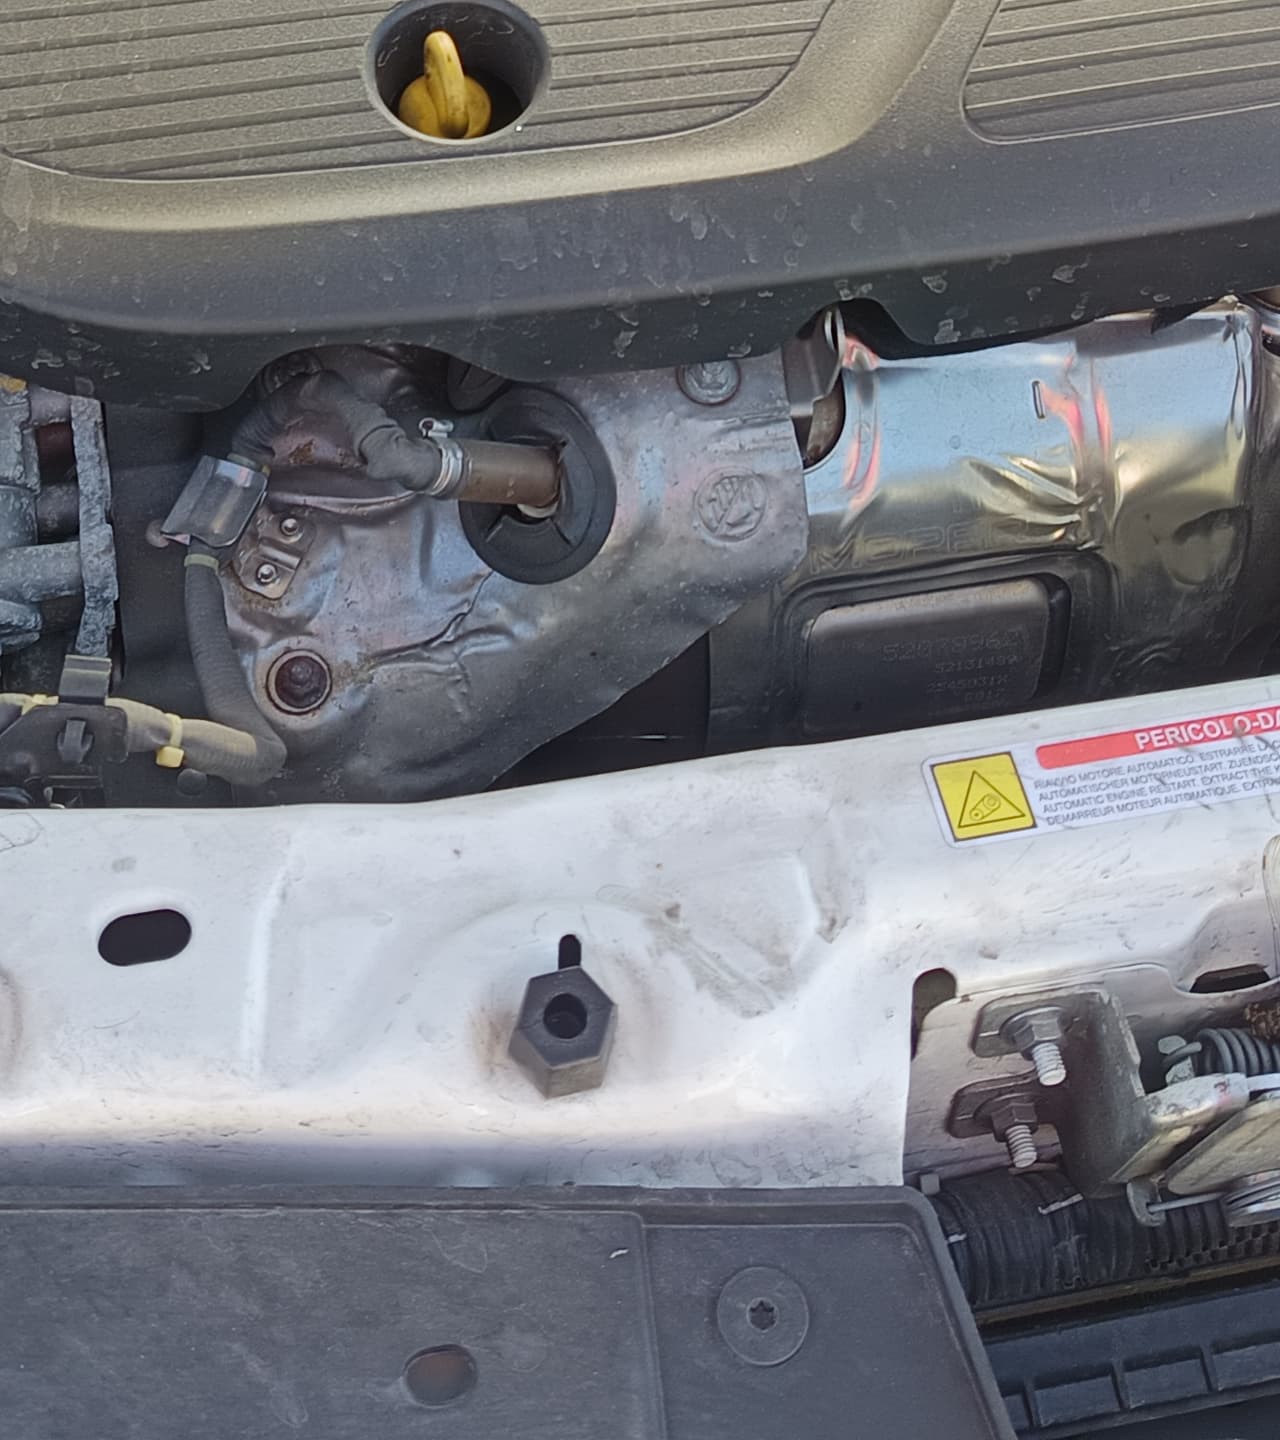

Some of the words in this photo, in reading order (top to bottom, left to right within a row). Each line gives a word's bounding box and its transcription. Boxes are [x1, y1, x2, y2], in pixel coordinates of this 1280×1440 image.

[1077, 765, 1125, 782] MOTORE
[1038, 777, 1128, 801] AUTOMATISCHER
[1042, 794, 1104, 812] AUTOMATIC
[1105, 786, 1147, 802] ENGINE
[1200, 769, 1248, 786] EXTRACT
[1250, 765, 1274, 777] THE
[1046, 805, 1114, 825] DEMARREUR
[1115, 797, 1162, 813] MOTEUR
